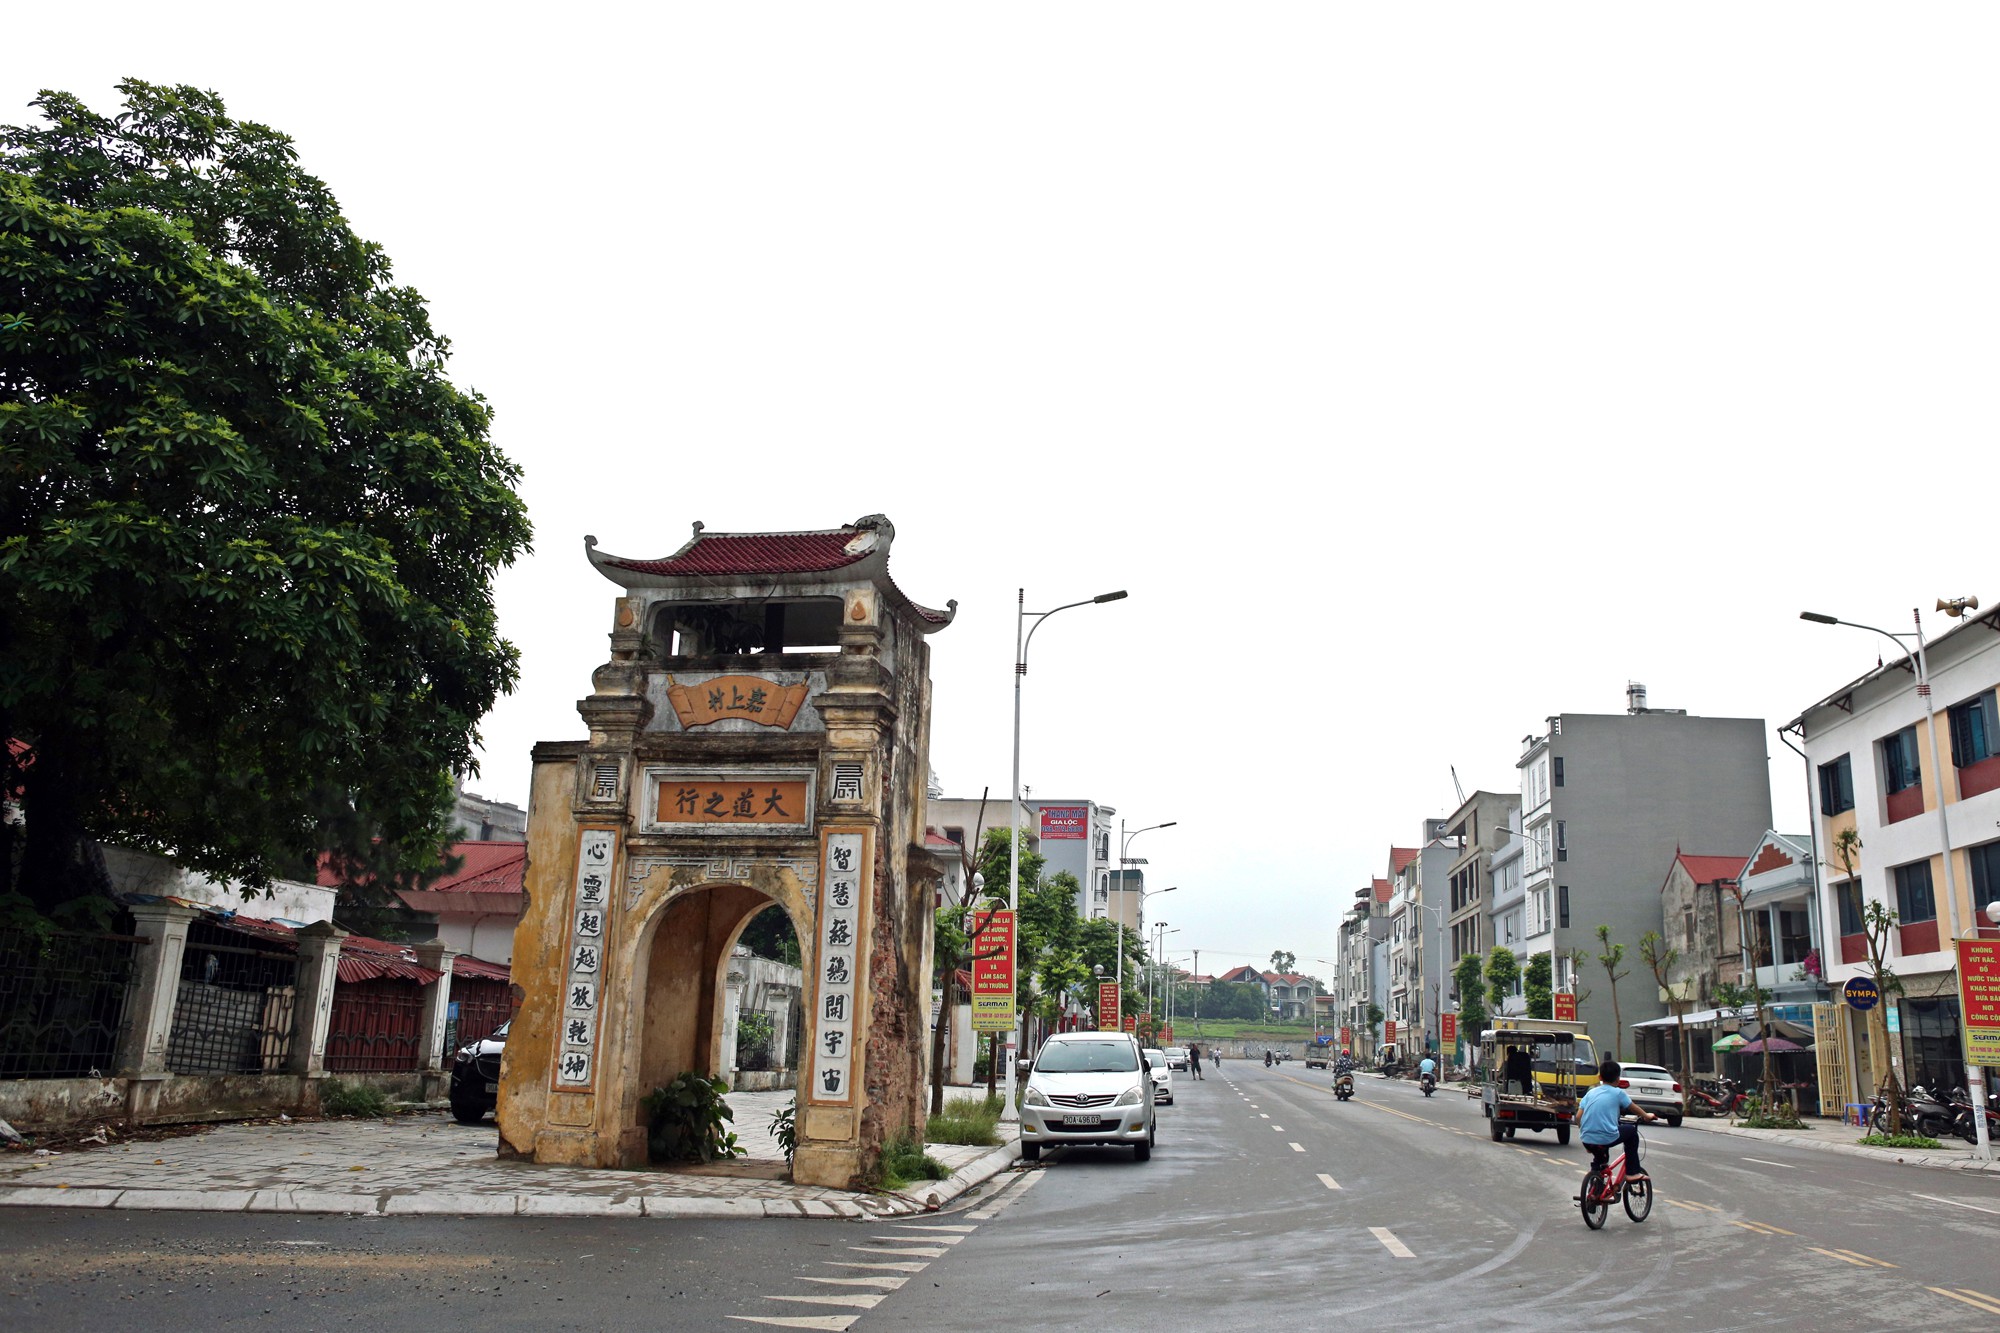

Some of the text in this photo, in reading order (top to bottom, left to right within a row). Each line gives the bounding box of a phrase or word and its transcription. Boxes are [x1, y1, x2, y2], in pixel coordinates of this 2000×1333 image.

[1048, 808, 1086, 818] THANG MÁY
[1969, 955, 1980, 963] VỨT
